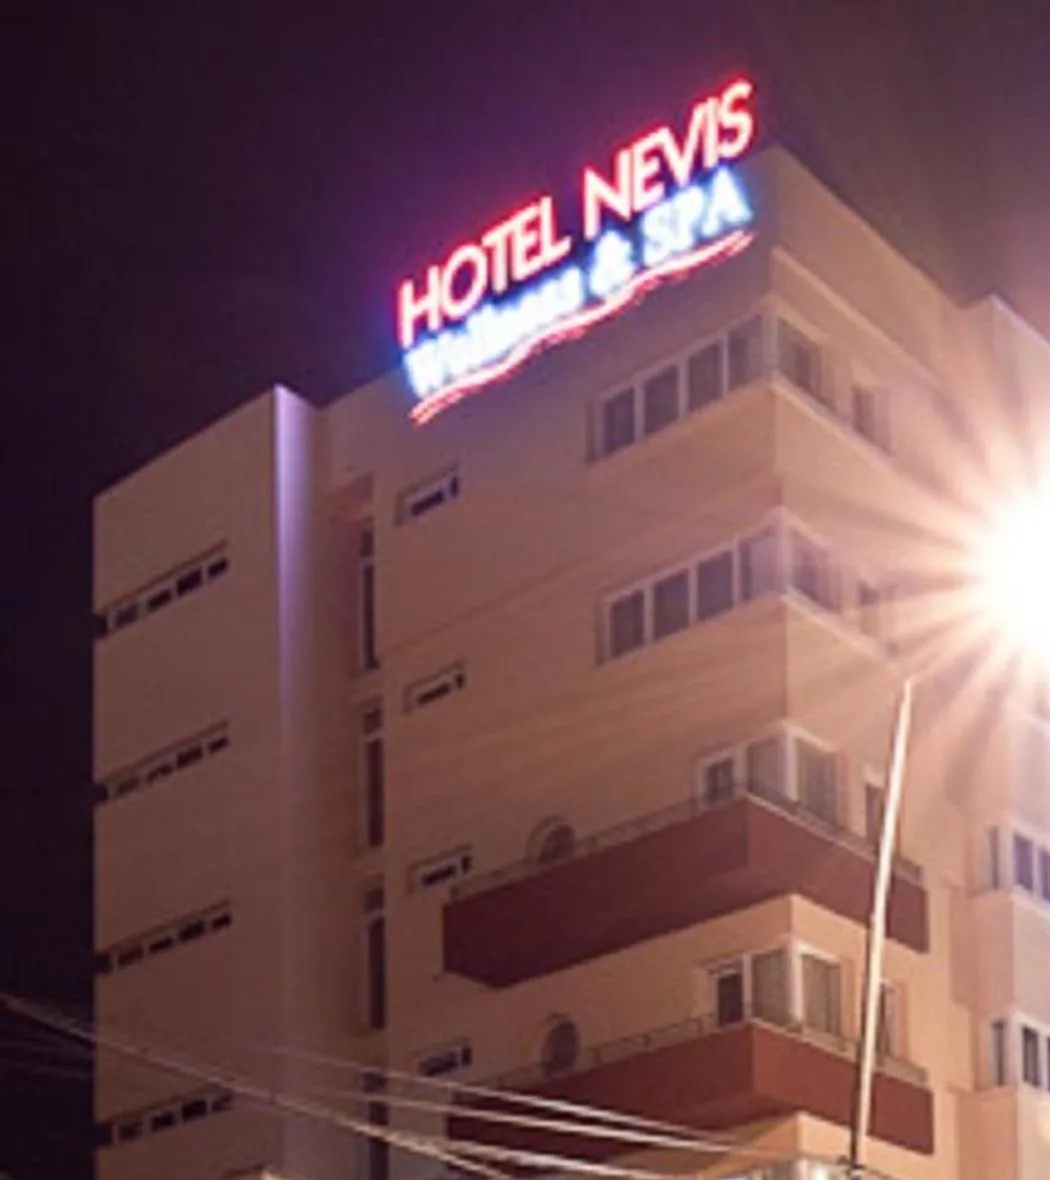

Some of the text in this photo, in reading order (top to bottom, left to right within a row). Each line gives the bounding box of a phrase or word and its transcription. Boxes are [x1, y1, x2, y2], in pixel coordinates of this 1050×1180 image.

[398, 77, 755, 349] HOTEL NEVIS
[641, 164, 754, 264] SPA
